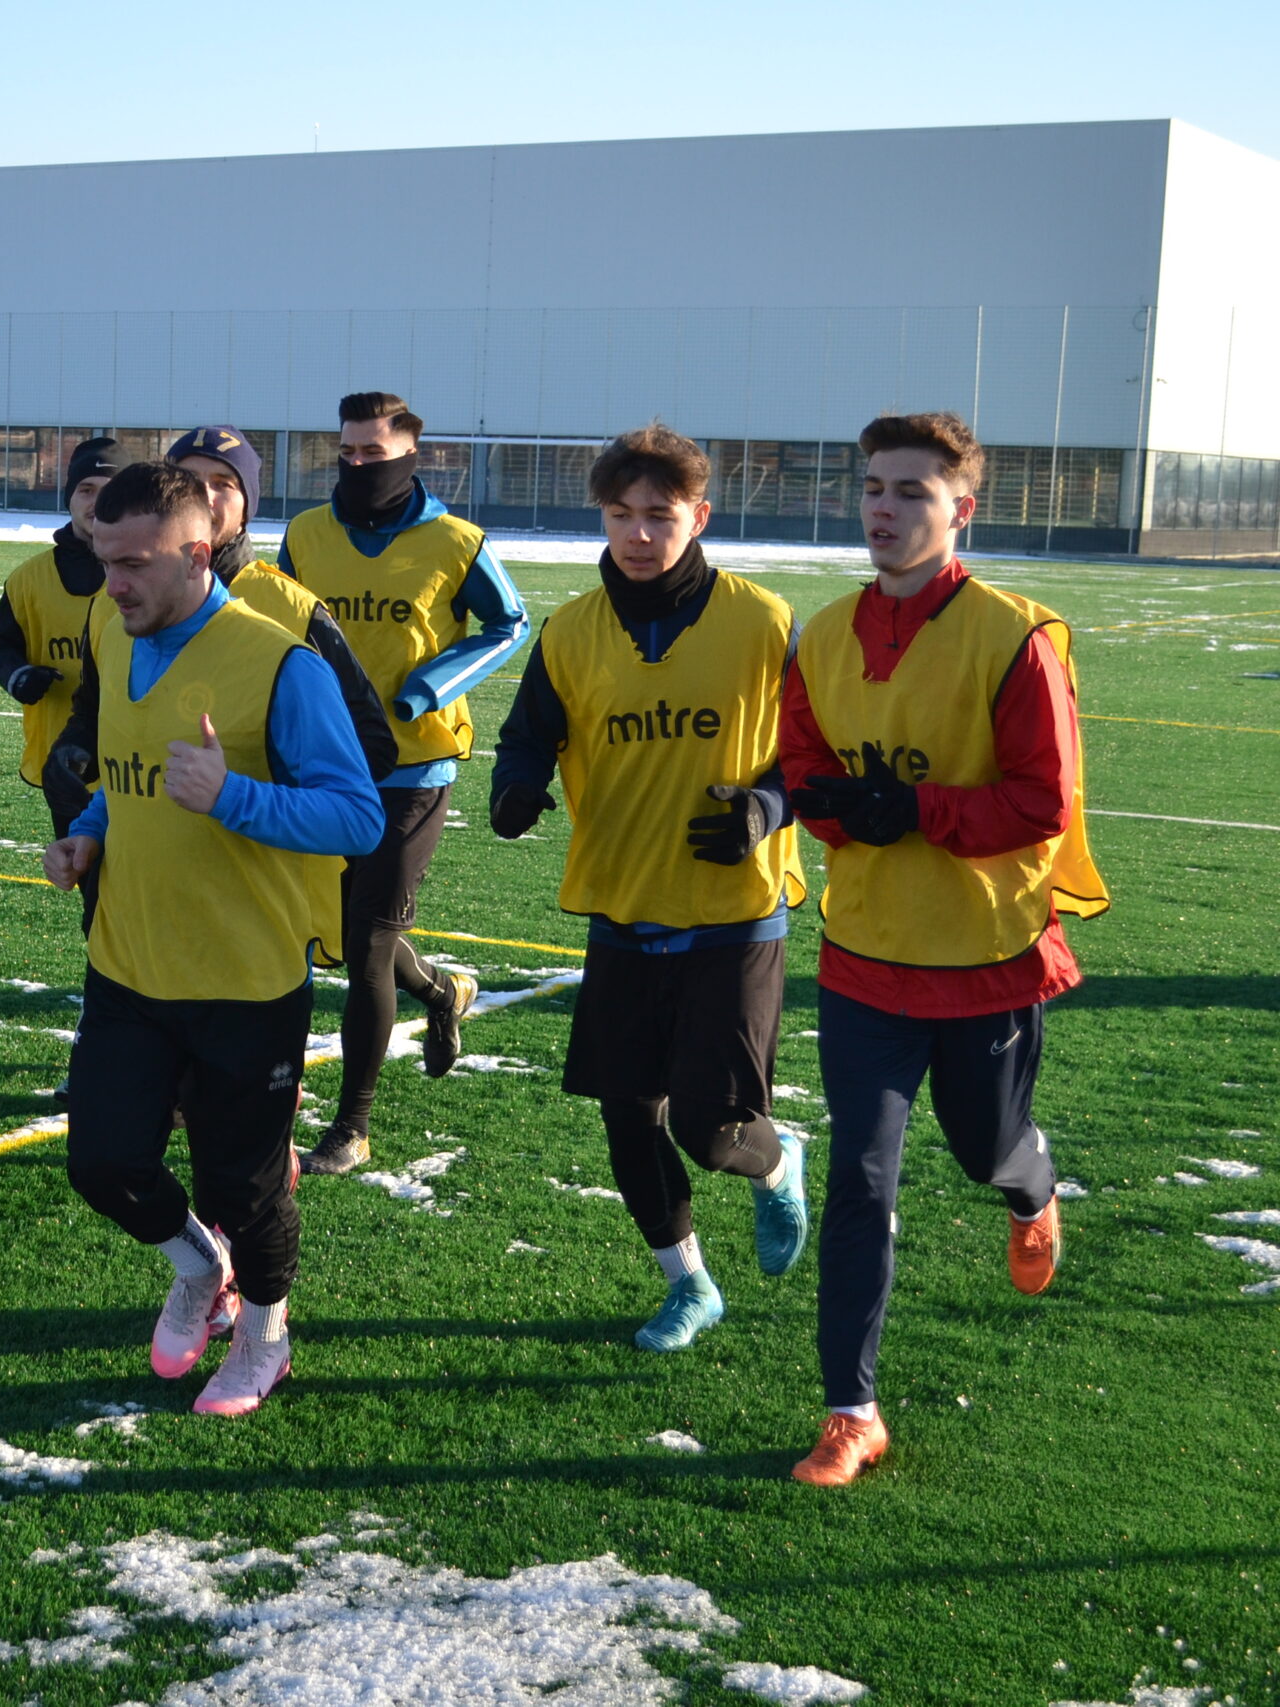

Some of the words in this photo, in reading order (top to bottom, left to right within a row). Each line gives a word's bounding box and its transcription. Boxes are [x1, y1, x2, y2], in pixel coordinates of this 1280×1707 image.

[192, 429, 241, 453] 17
[324, 590, 412, 624] mitre
[607, 699, 721, 745] mitre
[104, 752, 167, 798] mitr
